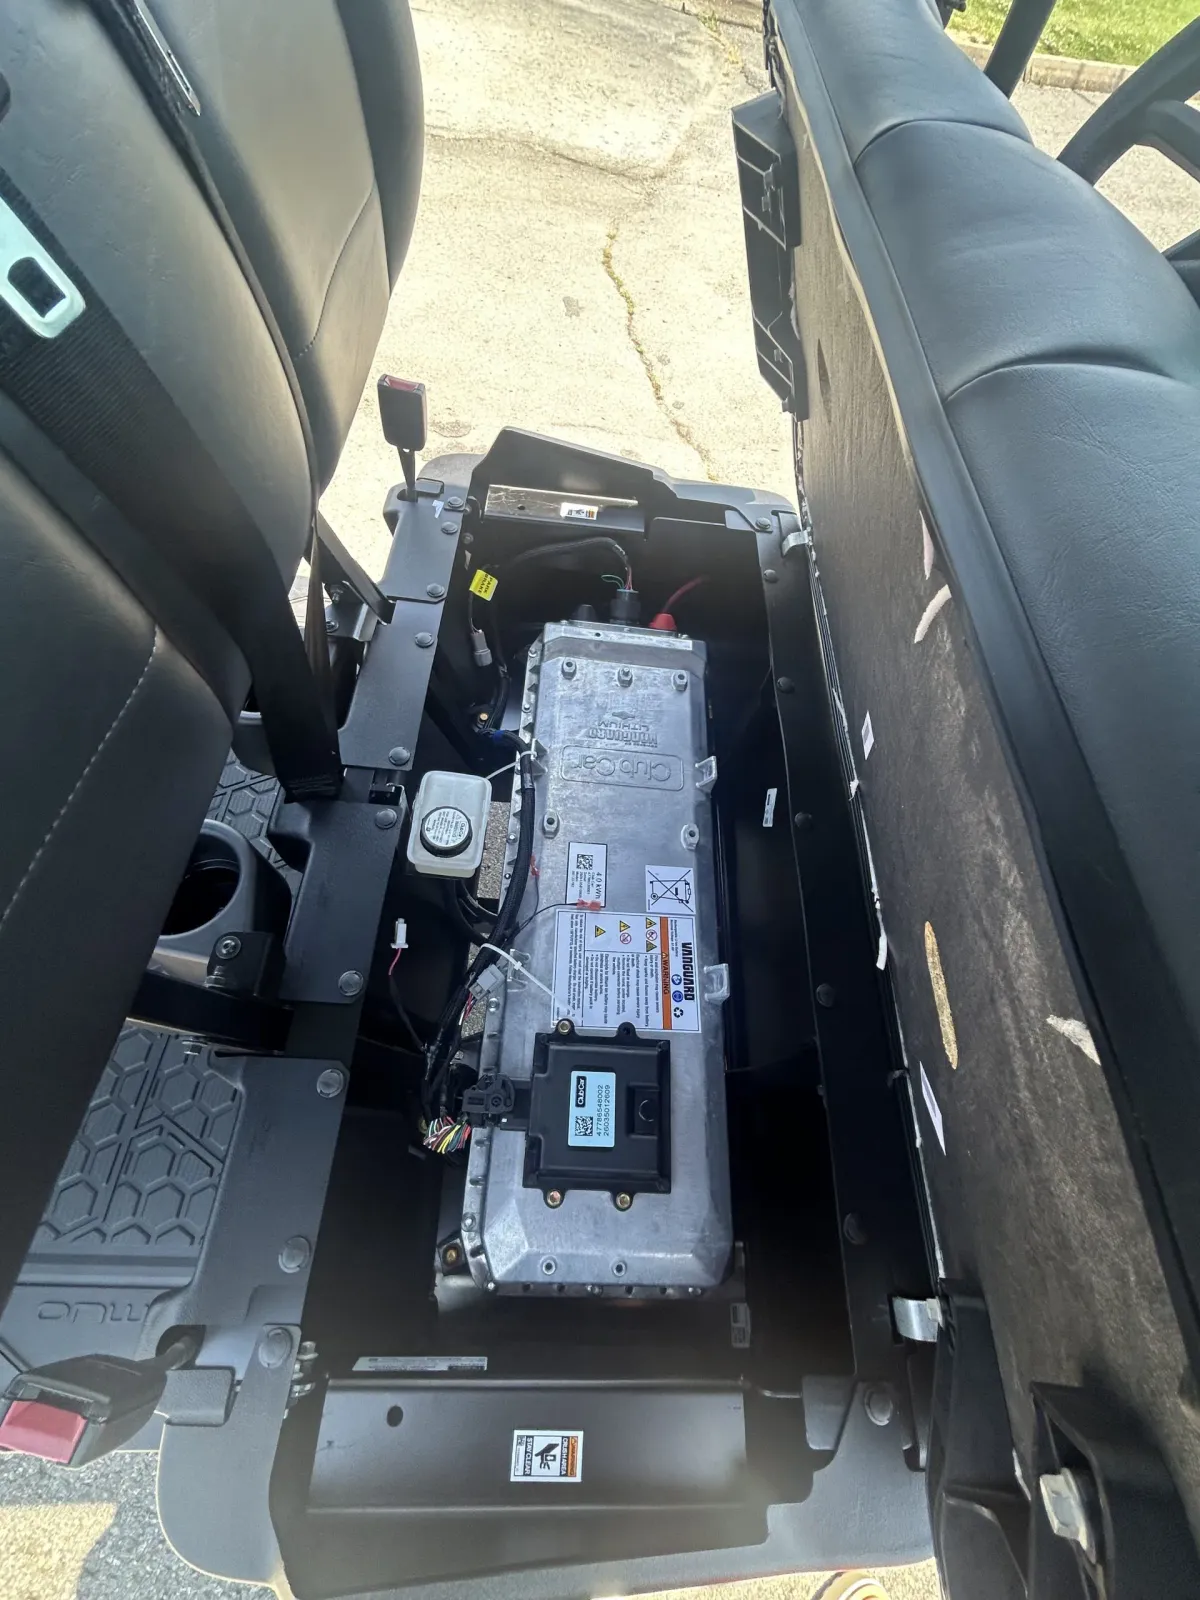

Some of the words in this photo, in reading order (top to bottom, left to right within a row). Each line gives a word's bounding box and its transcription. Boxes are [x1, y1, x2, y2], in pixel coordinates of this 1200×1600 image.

[478, 574, 488, 594] BRAKE
[484, 577, 493, 594] PARK
[588, 728, 658, 744] VANGUARD
[597, 721, 649, 732] LITHIUM
[571, 755, 616, 777] Car
[619, 759, 672, 782] Club
[682, 942, 695, 1001] VANGUARD
